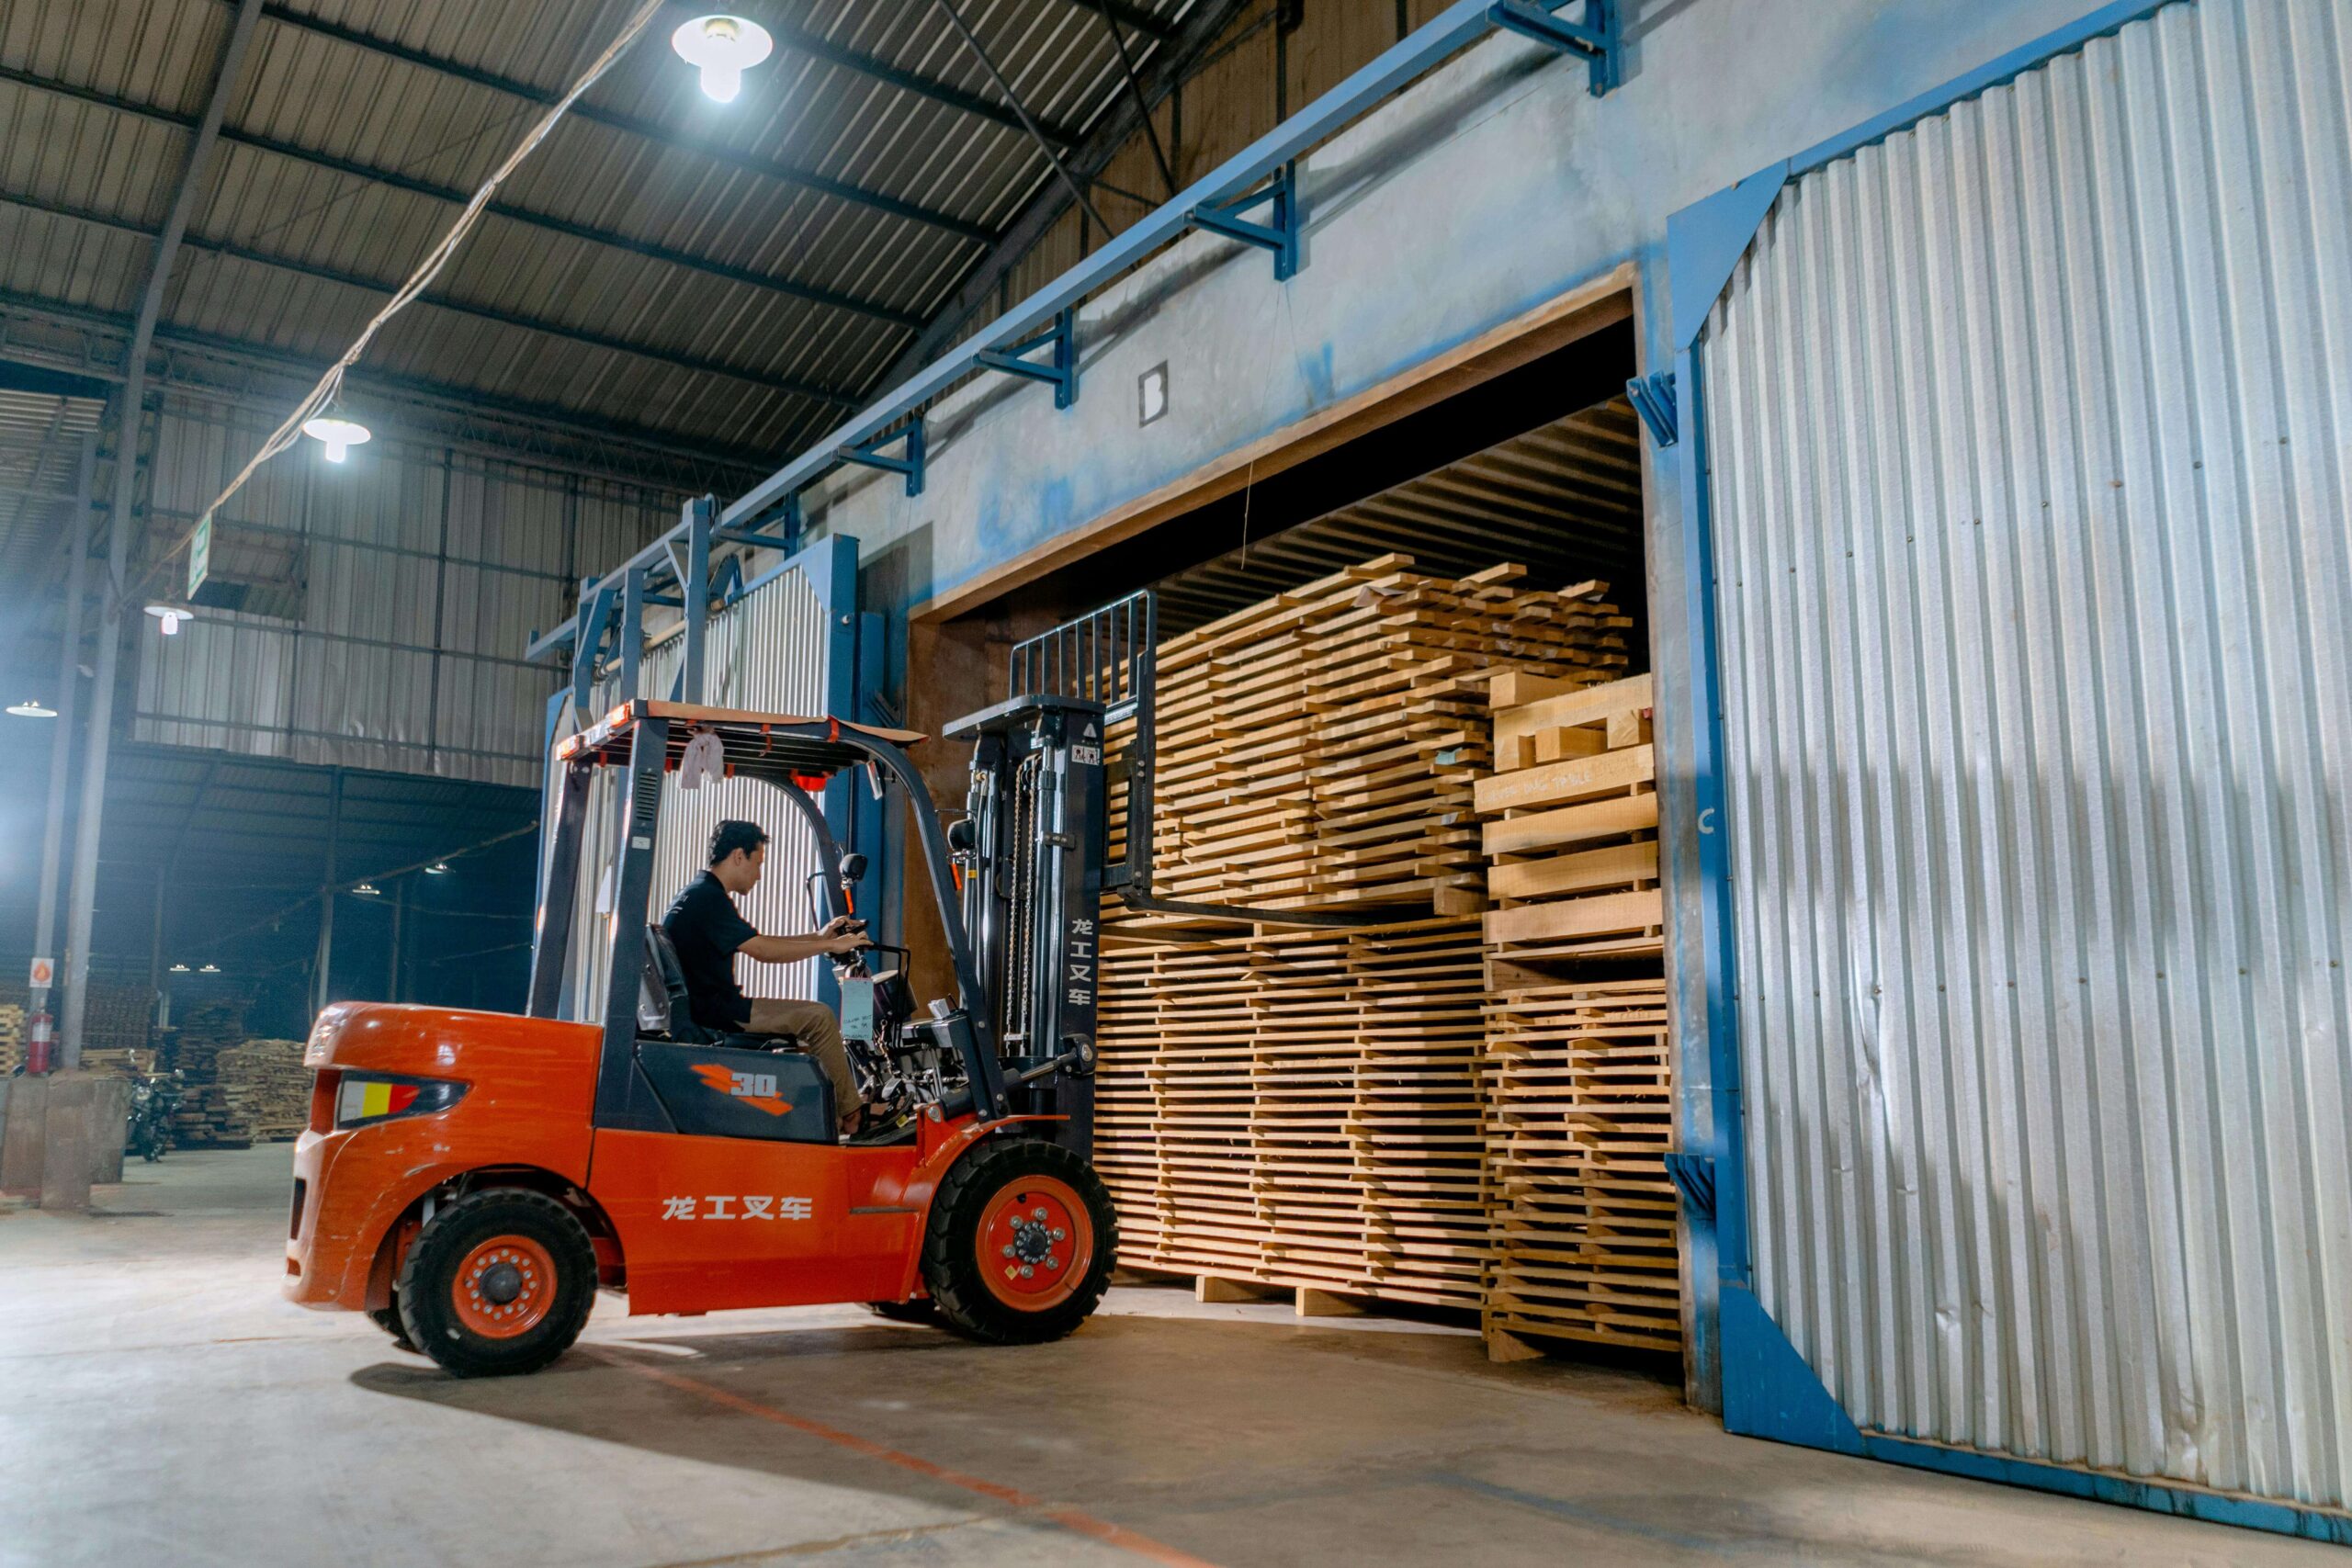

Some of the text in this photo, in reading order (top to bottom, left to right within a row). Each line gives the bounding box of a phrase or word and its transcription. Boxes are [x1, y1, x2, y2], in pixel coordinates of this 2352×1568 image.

[1144, 372, 1163, 421] B
[730, 1072, 777, 1097] 30
[662, 1196, 813, 1221] 龙工叉车
